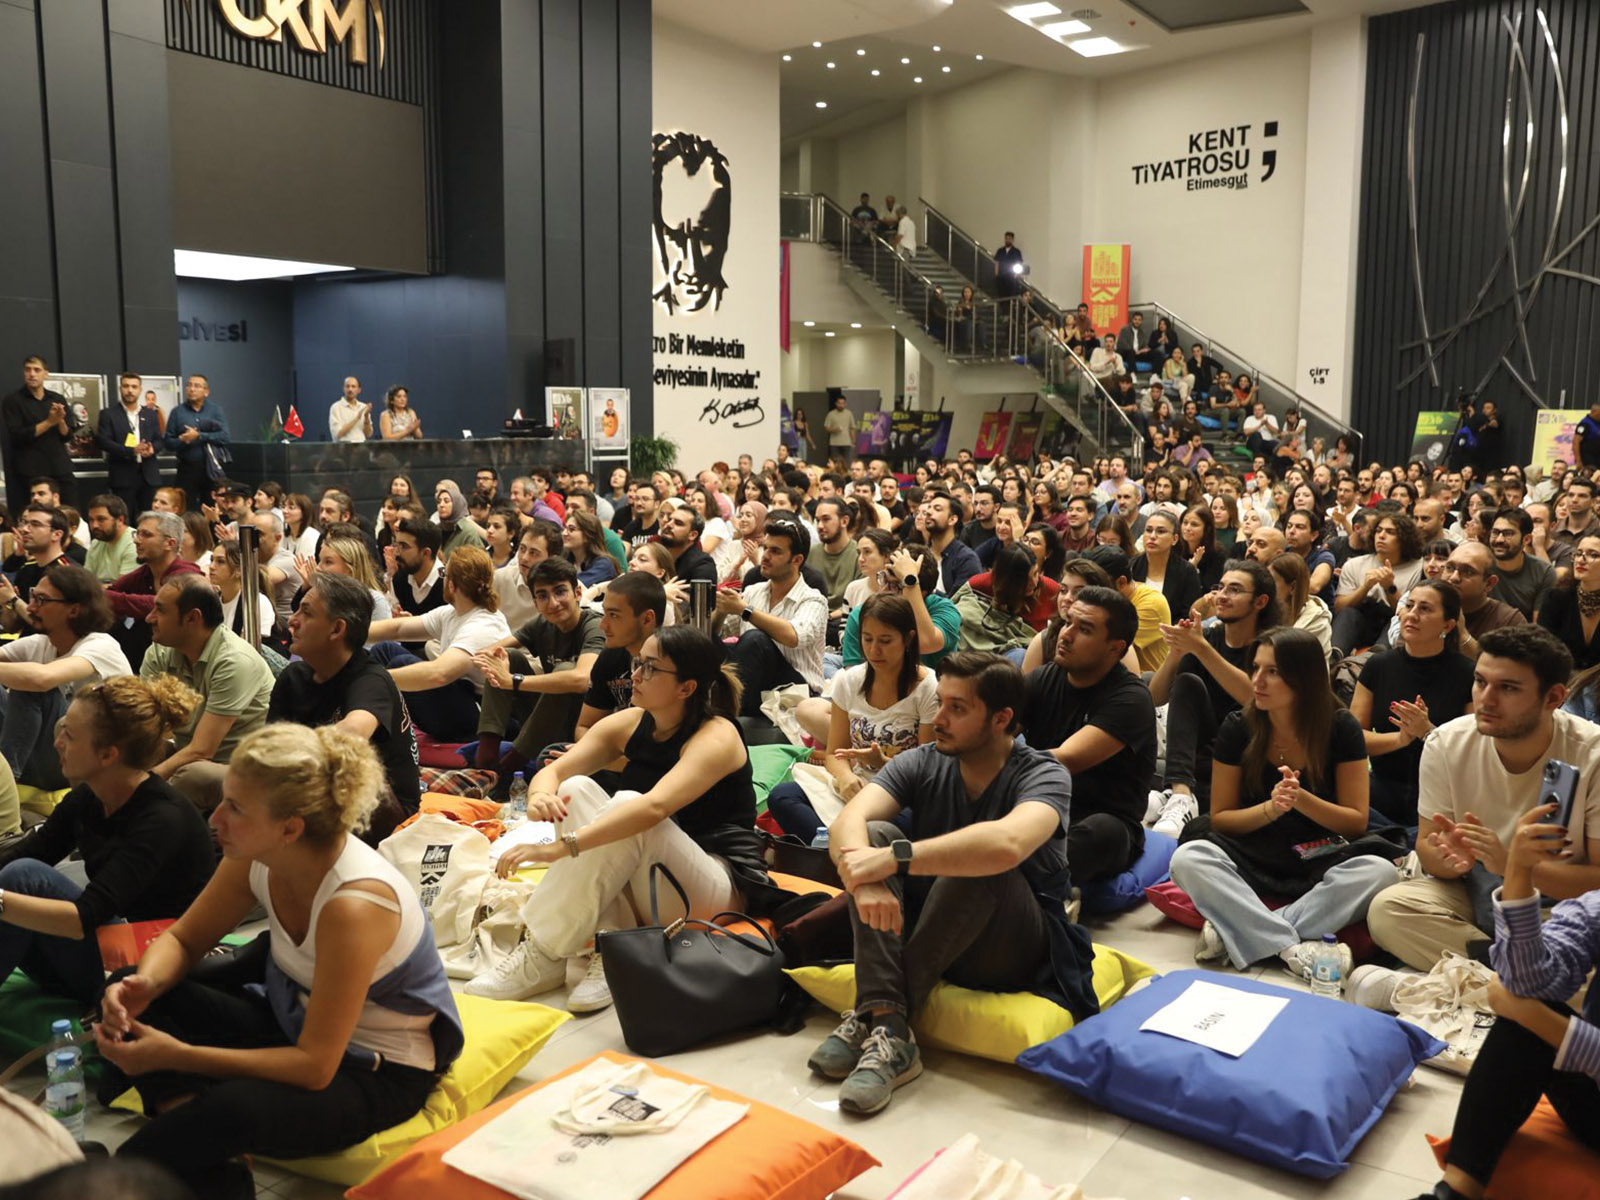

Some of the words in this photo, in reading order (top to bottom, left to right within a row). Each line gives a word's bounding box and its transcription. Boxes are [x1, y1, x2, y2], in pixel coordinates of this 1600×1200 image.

[1189, 125, 1252, 154] KENT
[1187, 172, 1248, 191] Etimesgut
[669, 333, 685, 354] Bir
[686, 334, 745, 359] Memleketin
